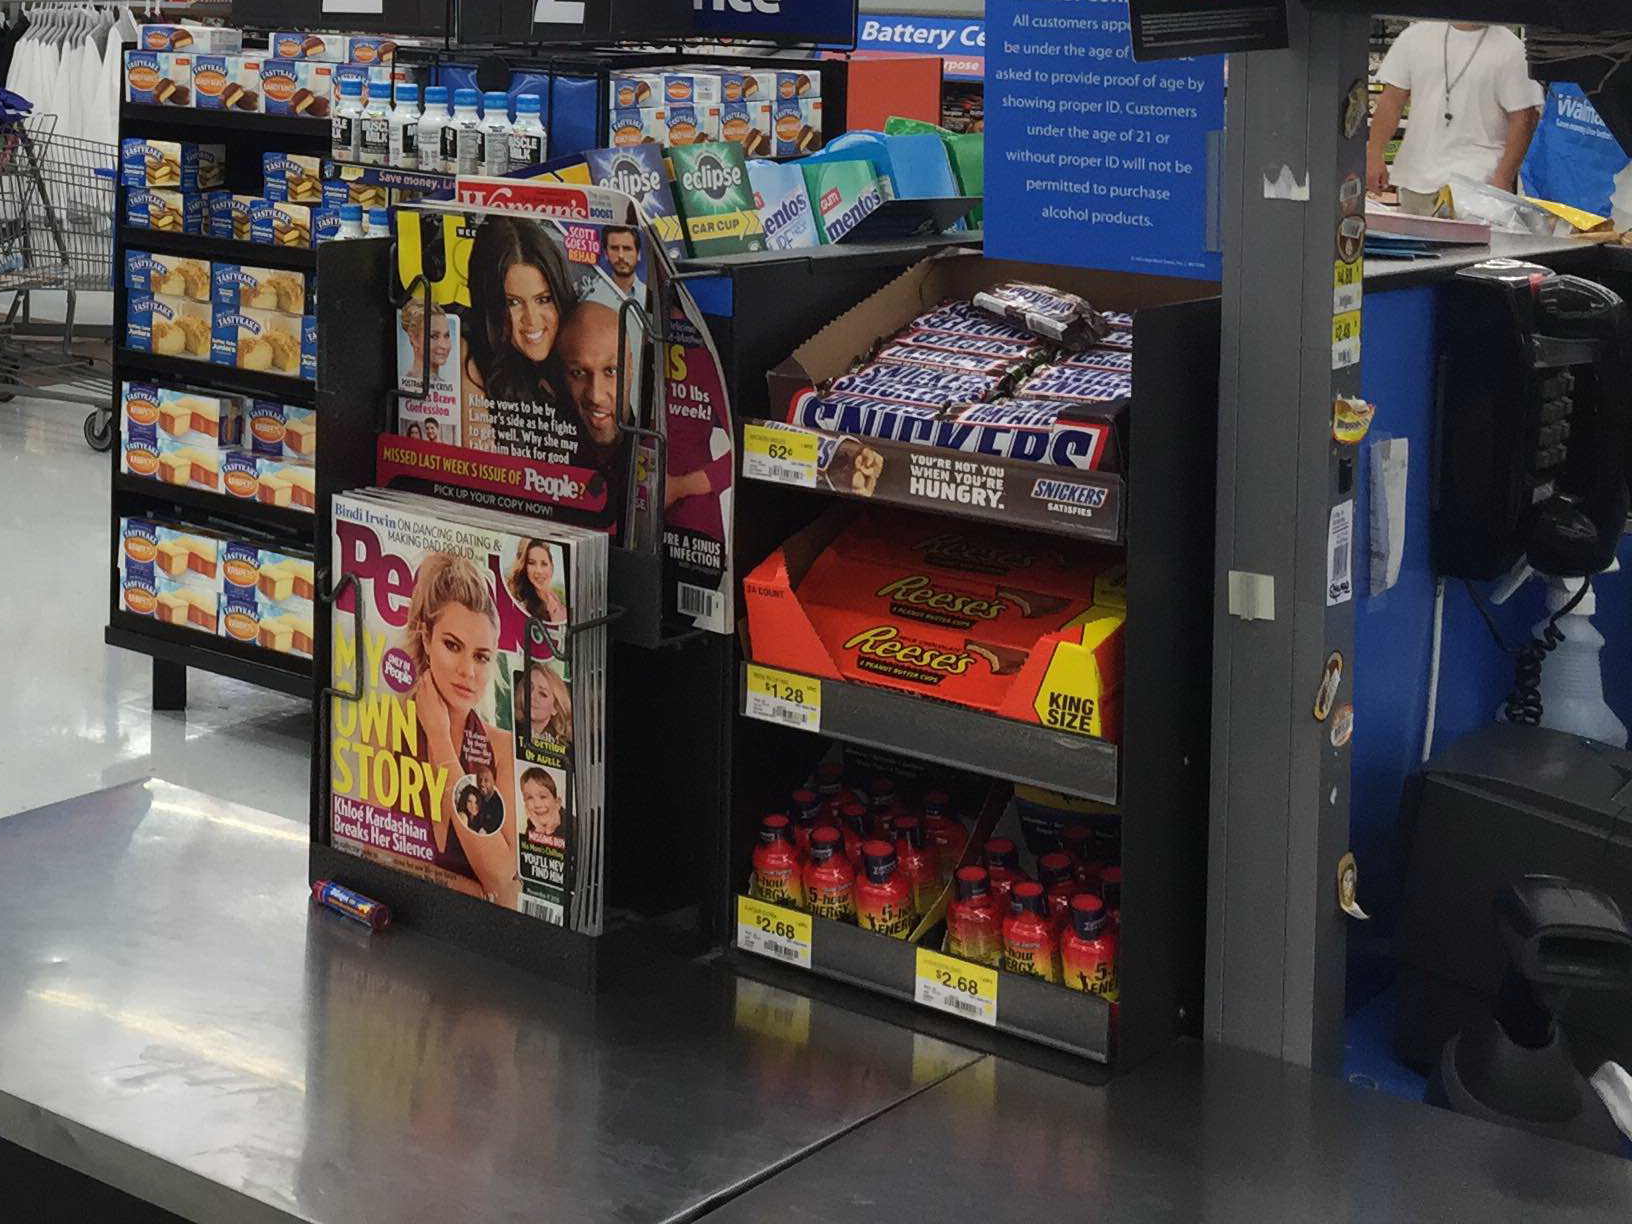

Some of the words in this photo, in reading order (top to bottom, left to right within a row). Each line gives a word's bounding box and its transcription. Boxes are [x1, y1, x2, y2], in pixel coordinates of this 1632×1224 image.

[862, 21, 956, 49] Battery
[960, 26, 985, 47] Ce
[1004, 41, 1020, 54] be
[1023, 42, 1060, 56] under
[1064, 42, 1085, 57] the
[1088, 47, 1112, 61] age
[1115, 46, 1130, 58] of
[995, 69, 1032, 81] asked
[1035, 71, 1048, 82] to
[1051, 71, 1101, 86] provide
[1103, 75, 1140, 88] proof
[1143, 75, 1157, 87] of
[1159, 80, 1184, 91] age
[1187, 78, 1205, 93] by
[1002, 96, 1056, 111] showing
[1058, 98, 1102, 113] proper
[1106, 101, 1123, 114] ID.
[1126, 102, 1197, 118] Customers
[1027, 124, 1065, 138] under
[1068, 125, 1089, 139] the
[1092, 129, 1116, 143] age
[1120, 128, 1135, 141] of
[1136, 130, 1151, 143] 21
[1155, 132, 1171, 144] or
[1006, 150, 1056, 164] without
[1058, 152, 1101, 168] proper
[1105, 155, 1119, 168] ID
[1122, 156, 1145, 170] will
[1148, 159, 1171, 172] not
[1175, 161, 1193, 174] be
[379, 172, 401, 184] Save
[404, 175, 441, 189] money.
[443, 179, 456, 189] Li
[600, 168, 661, 194] eclipse
[683, 164, 741, 192] eclipse
[1026, 178, 1090, 194] permitted
[1093, 183, 1107, 194] to
[1110, 184, 1171, 201] purchase
[461, 186, 589, 219] Woman's
[590, 207, 613, 220] BOOST
[764, 193, 807, 236] entos
[692, 221, 715, 234] CAR
[717, 219, 740, 232] CUP
[826, 188, 881, 243] mentos
[1042, 206, 1089, 221] alcohol
[1091, 208, 1154, 227] products.
[565, 237, 589, 251] GOES
[589, 241, 600, 253] TO
[568, 227, 596, 240] SCOTT
[568, 248, 597, 264] REHAB
[432, 392, 456, 405] Brave
[672, 382, 686, 399] 10
[690, 384, 711, 403] lbs
[405, 400, 450, 417] Confession
[669, 402, 712, 421] week!
[803, 395, 1093, 470] SNICKERS
[383, 447, 417, 467] MISSED
[419, 452, 441, 471] LAST
[479, 462, 507, 482] ISSUE
[508, 468, 522, 485] OF
[910, 465, 950, 482] WHEN
[954, 471, 1005, 490] YOU'RE
[911, 454, 952, 469] YOU'RE
[955, 460, 977, 474] NOT
[981, 464, 1005, 478] YOU
[909, 478, 1006, 510] HUNGRY.
[1034, 481, 1106, 506] SNICKERS
[1047, 503, 1093, 517] SATISFIES
[669, 548, 721, 569] INFECTION
[877, 574, 1007, 621] Reese's
[334, 623, 386, 689] MY
[841, 624, 977, 676] Reese's
[384, 663, 413, 686] People
[765, 681, 804, 704] $1.28
[1048, 691, 1095, 715] KING
[334, 684, 419, 757] OWN
[1047, 710, 1092, 733] SIZE
[332, 736, 449, 823] STORY
[334, 795, 364, 822] Khloé
[366, 805, 428, 842] Kardashian
[334, 814, 369, 841] Breaks
[371, 826, 391, 849] Her
[392, 832, 434, 861] Silence
[809, 887, 849, 906] 5-hour
[756, 914, 796, 940] $2.68
[935, 969, 978, 996] $2.68
